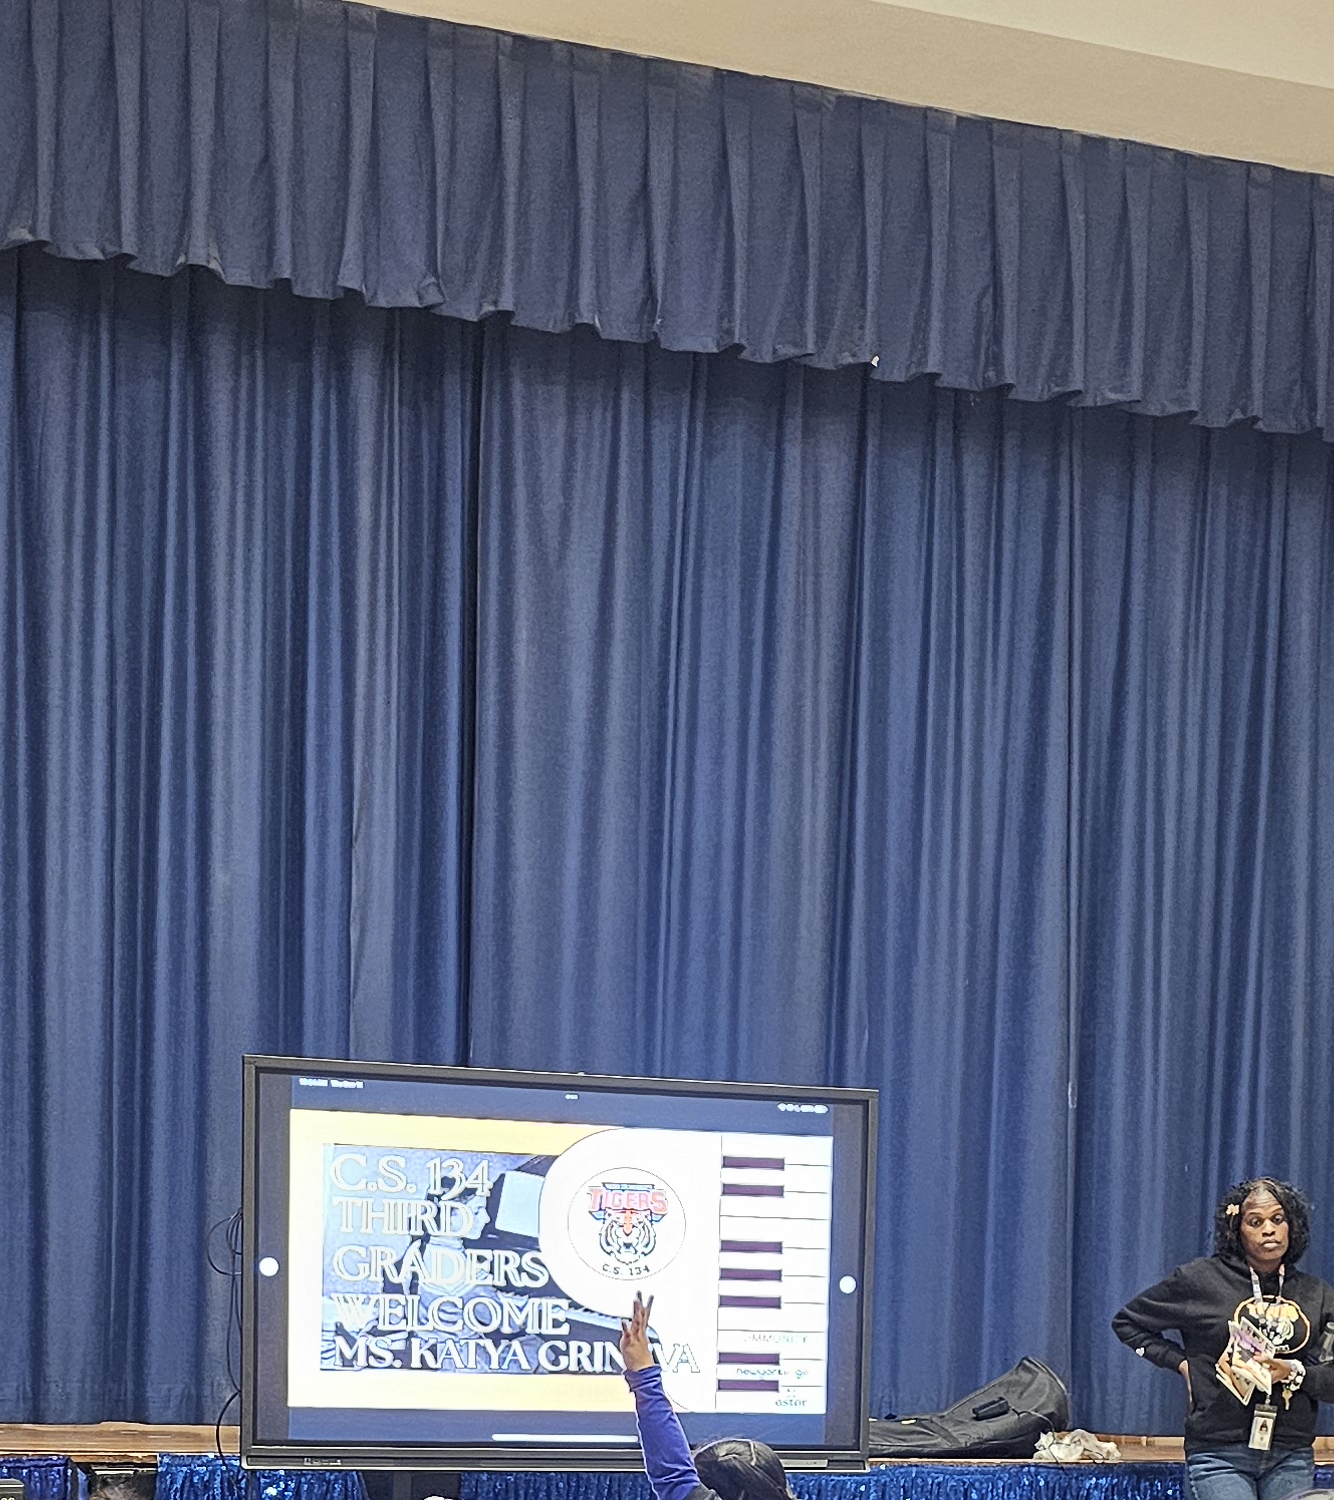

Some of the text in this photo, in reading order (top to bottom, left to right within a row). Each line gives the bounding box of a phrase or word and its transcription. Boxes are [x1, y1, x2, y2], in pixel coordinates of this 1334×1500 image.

[330, 1153, 493, 1200] C.S. 134
[333, 1196, 474, 1237] THIRD
[588, 1188, 667, 1213] TIGERS
[332, 1239, 549, 1288] GRADERS
[628, 1265, 650, 1276] 134
[331, 1293, 570, 1335] WELCOME
[334, 1336, 700, 1373] MS. KATYA GRINVA
